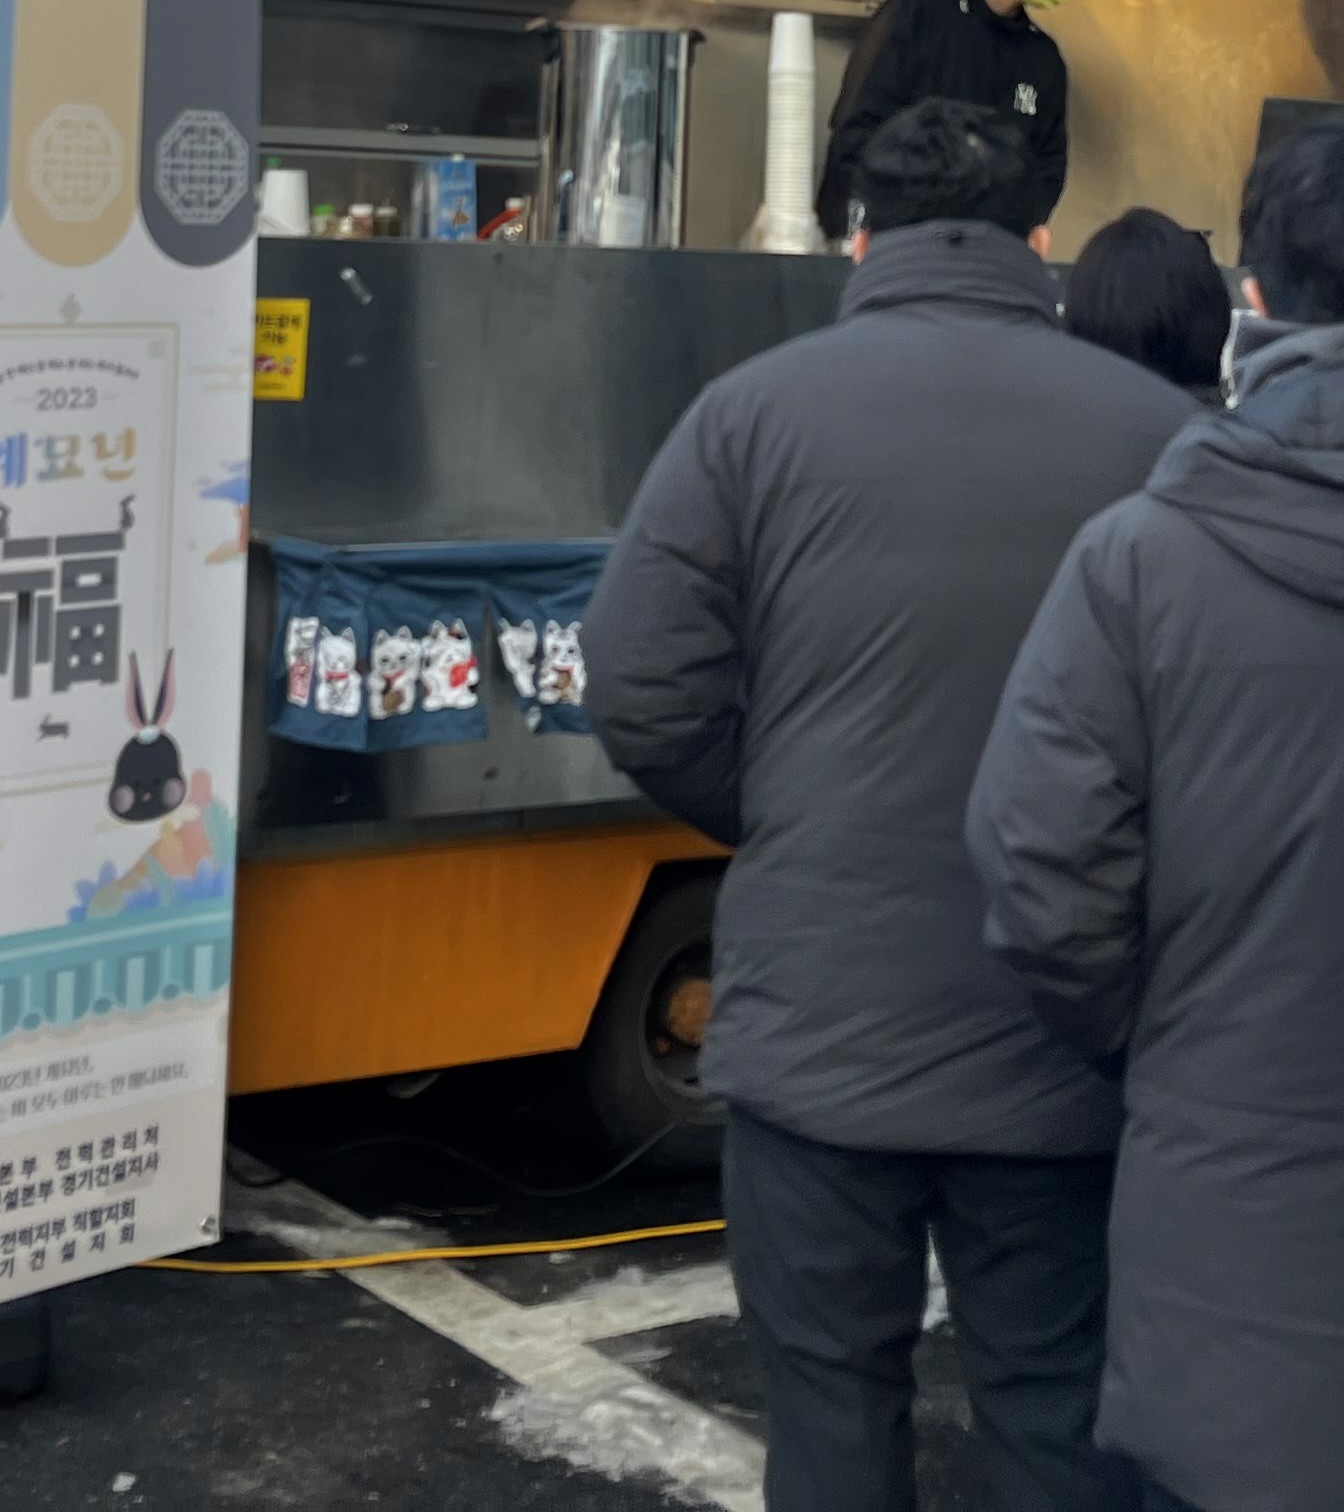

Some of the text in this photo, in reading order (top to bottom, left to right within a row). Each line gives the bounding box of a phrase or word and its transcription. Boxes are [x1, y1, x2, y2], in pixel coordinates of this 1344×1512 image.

[36, 386, 98, 411] 2023
[55, 1123, 160, 1171] 전력관리처
[61, 1151, 160, 1196] 경기건설지사
